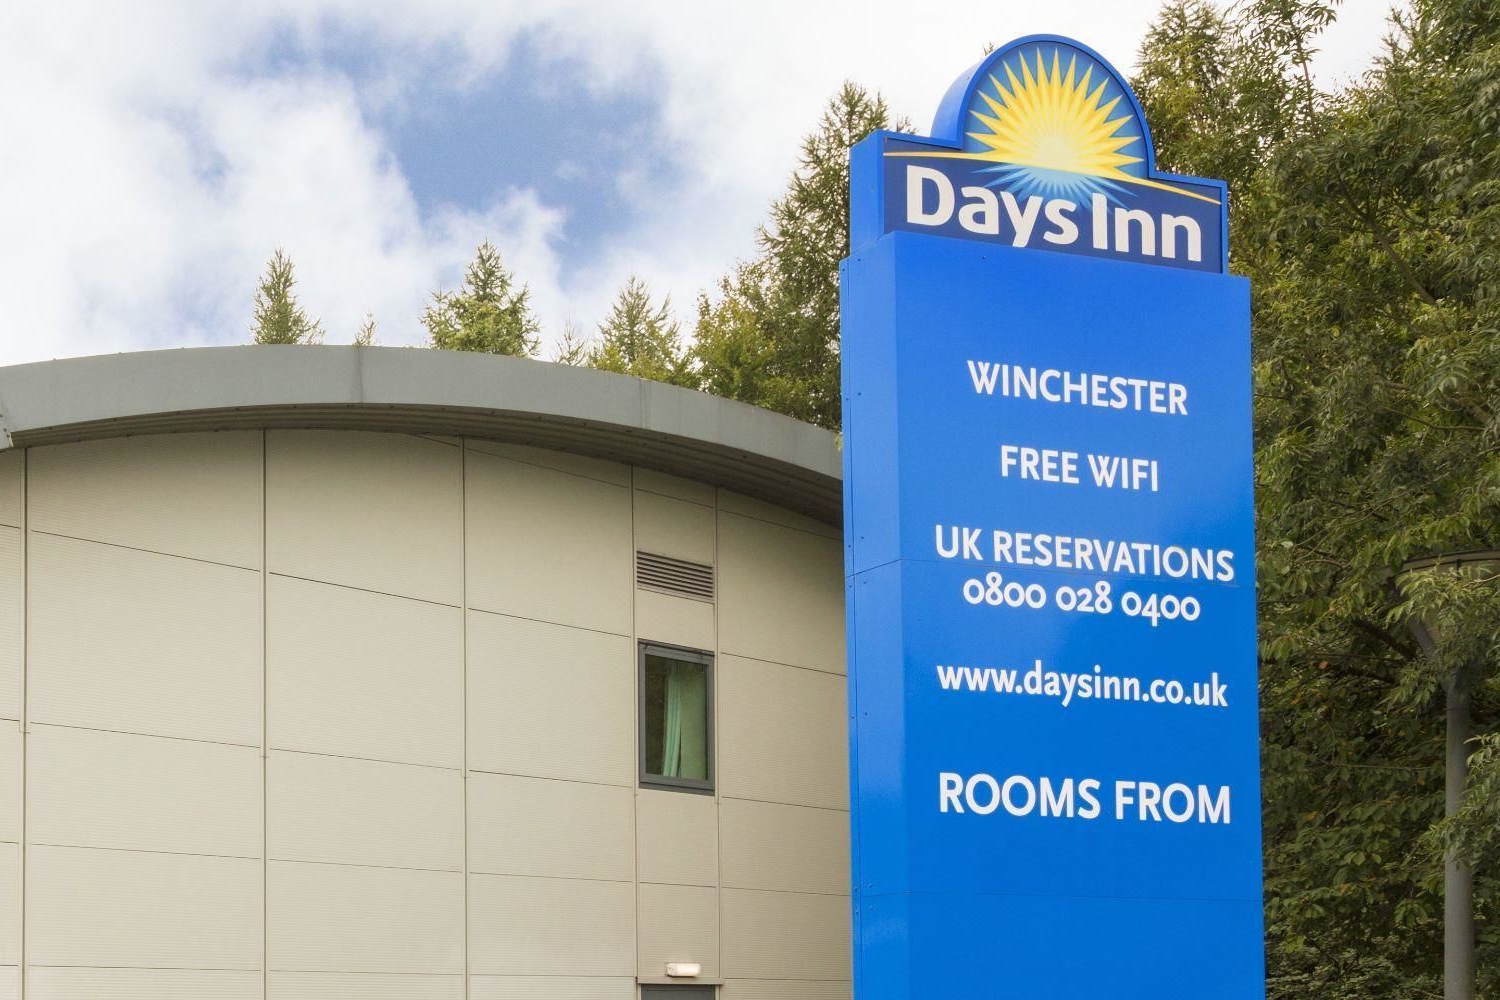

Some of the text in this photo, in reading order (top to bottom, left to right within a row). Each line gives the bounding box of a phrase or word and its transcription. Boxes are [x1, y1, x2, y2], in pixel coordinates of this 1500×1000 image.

[906, 164, 1202, 262] Days Inn
[967, 360, 1188, 415] WINCHESTER
[1001, 445, 1159, 491] FREE WIFI
[936, 525, 1235, 582] UK RESERVATIONS
[963, 572, 1201, 626] 0800 028 0400
[937, 660, 1228, 708] www.daysinn.co.uk
[940, 773, 1231, 824] ROOMS FROM
